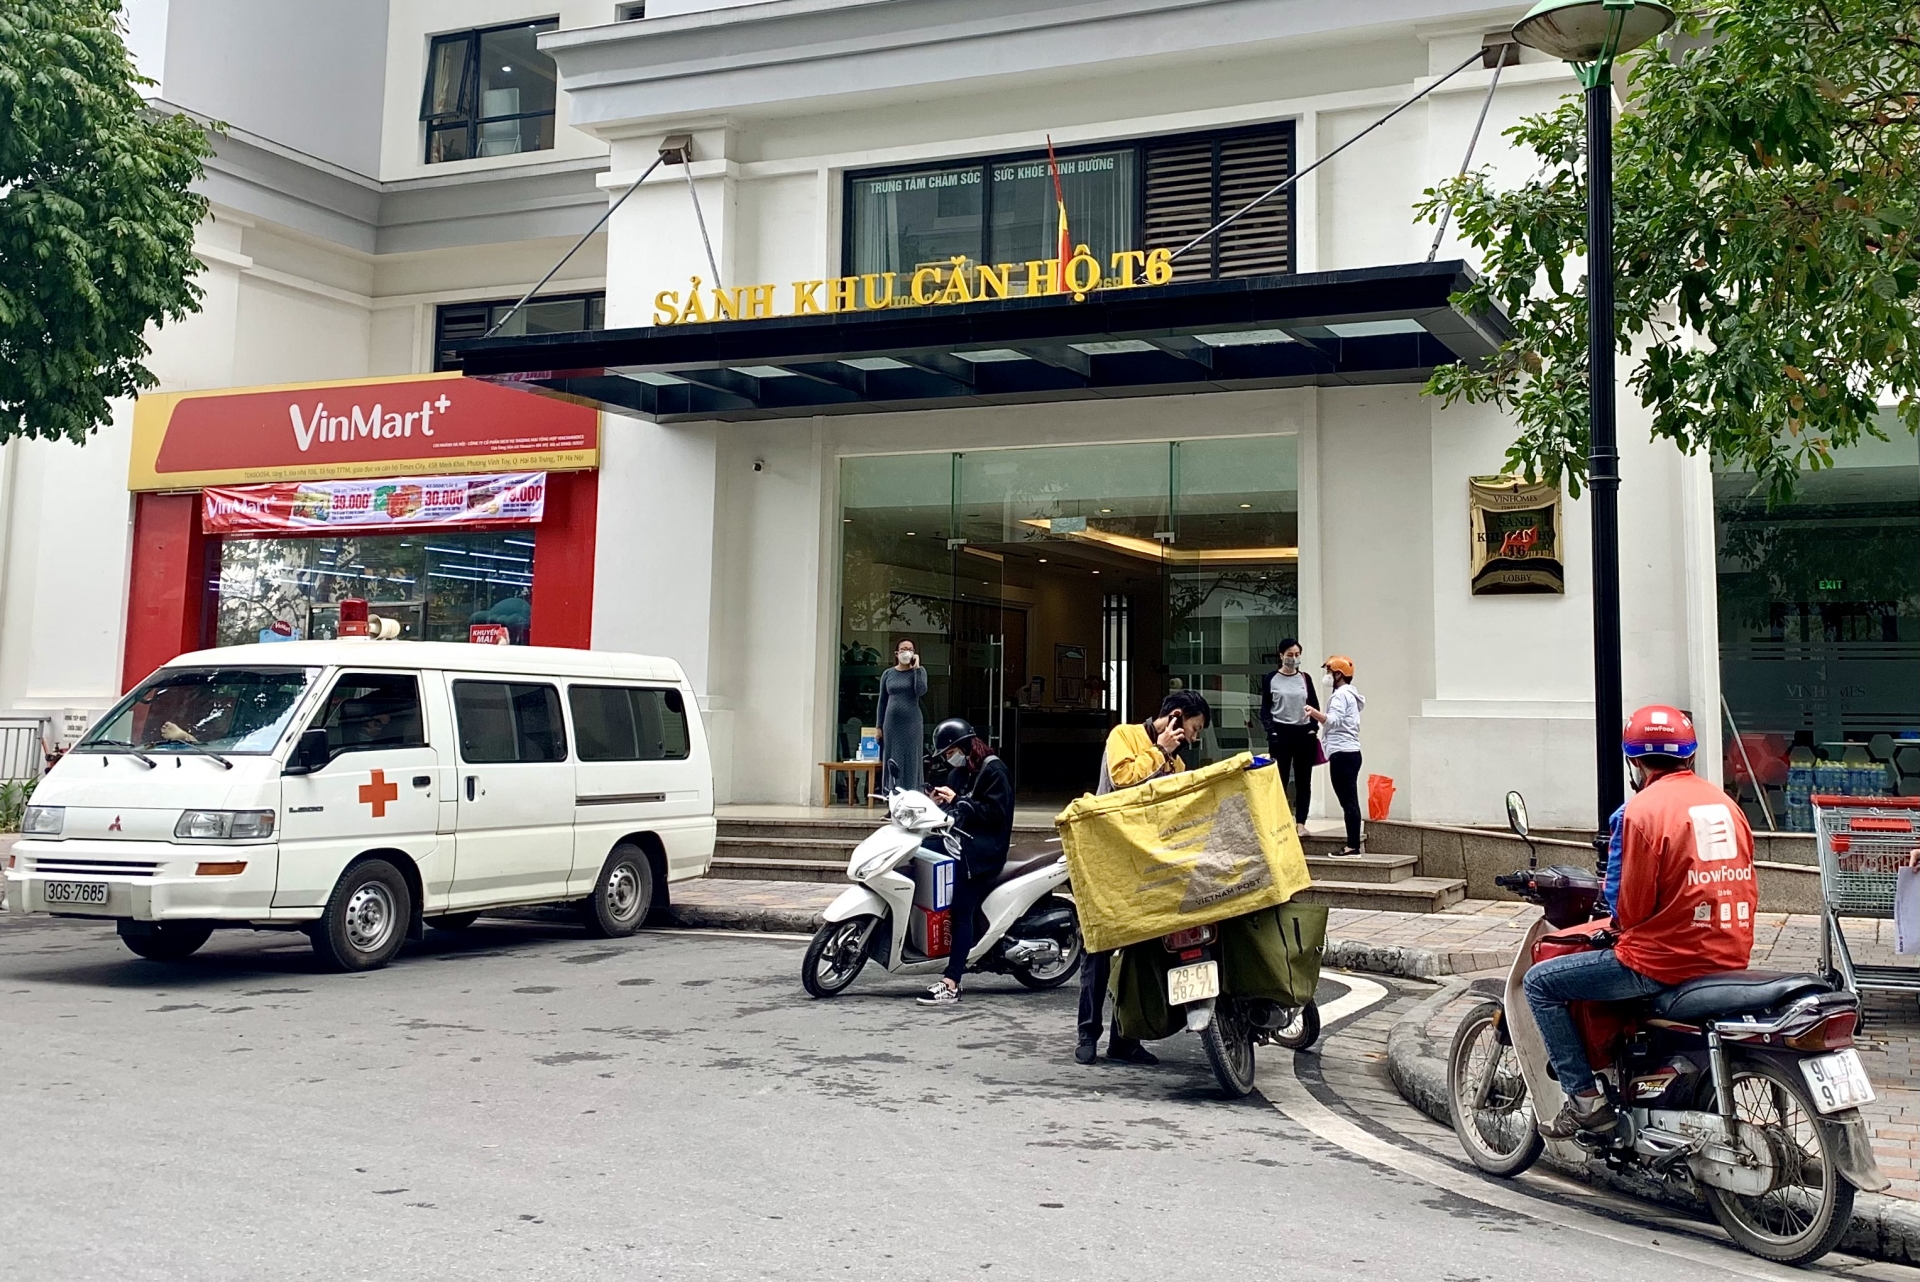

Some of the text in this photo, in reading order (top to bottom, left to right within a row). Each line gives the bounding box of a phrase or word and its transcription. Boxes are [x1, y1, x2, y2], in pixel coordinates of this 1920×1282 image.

[994, 165, 1015, 182] SỨC
[1017, 162, 1044, 179] KHỎE
[1078, 155, 1114, 173] ĐƯỜNG
[870, 169, 981, 194] TRUNG TÂM CHĂM SÓC
[653, 244, 1173, 326] SẢNH KHU CĂN HỘ T6
[289, 393, 452, 452] VinMart+
[1493, 495, 1538, 503] VINHOMES
[1498, 512, 1533, 527] SẢNH
[1508, 544, 1526, 557] T6
[1503, 574, 1532, 582] LOBBY
[1819, 580, 1843, 590] EXIT
[1644, 725, 1675, 733] NowFood
[1688, 864, 1752, 886] NowFood
[48, 882, 105, 902] 30S-7685
[1195, 877, 1261, 906] VIETNAM POST
[1175, 964, 1209, 984] 29-C1
[1173, 980, 1215, 1002] 582.74
